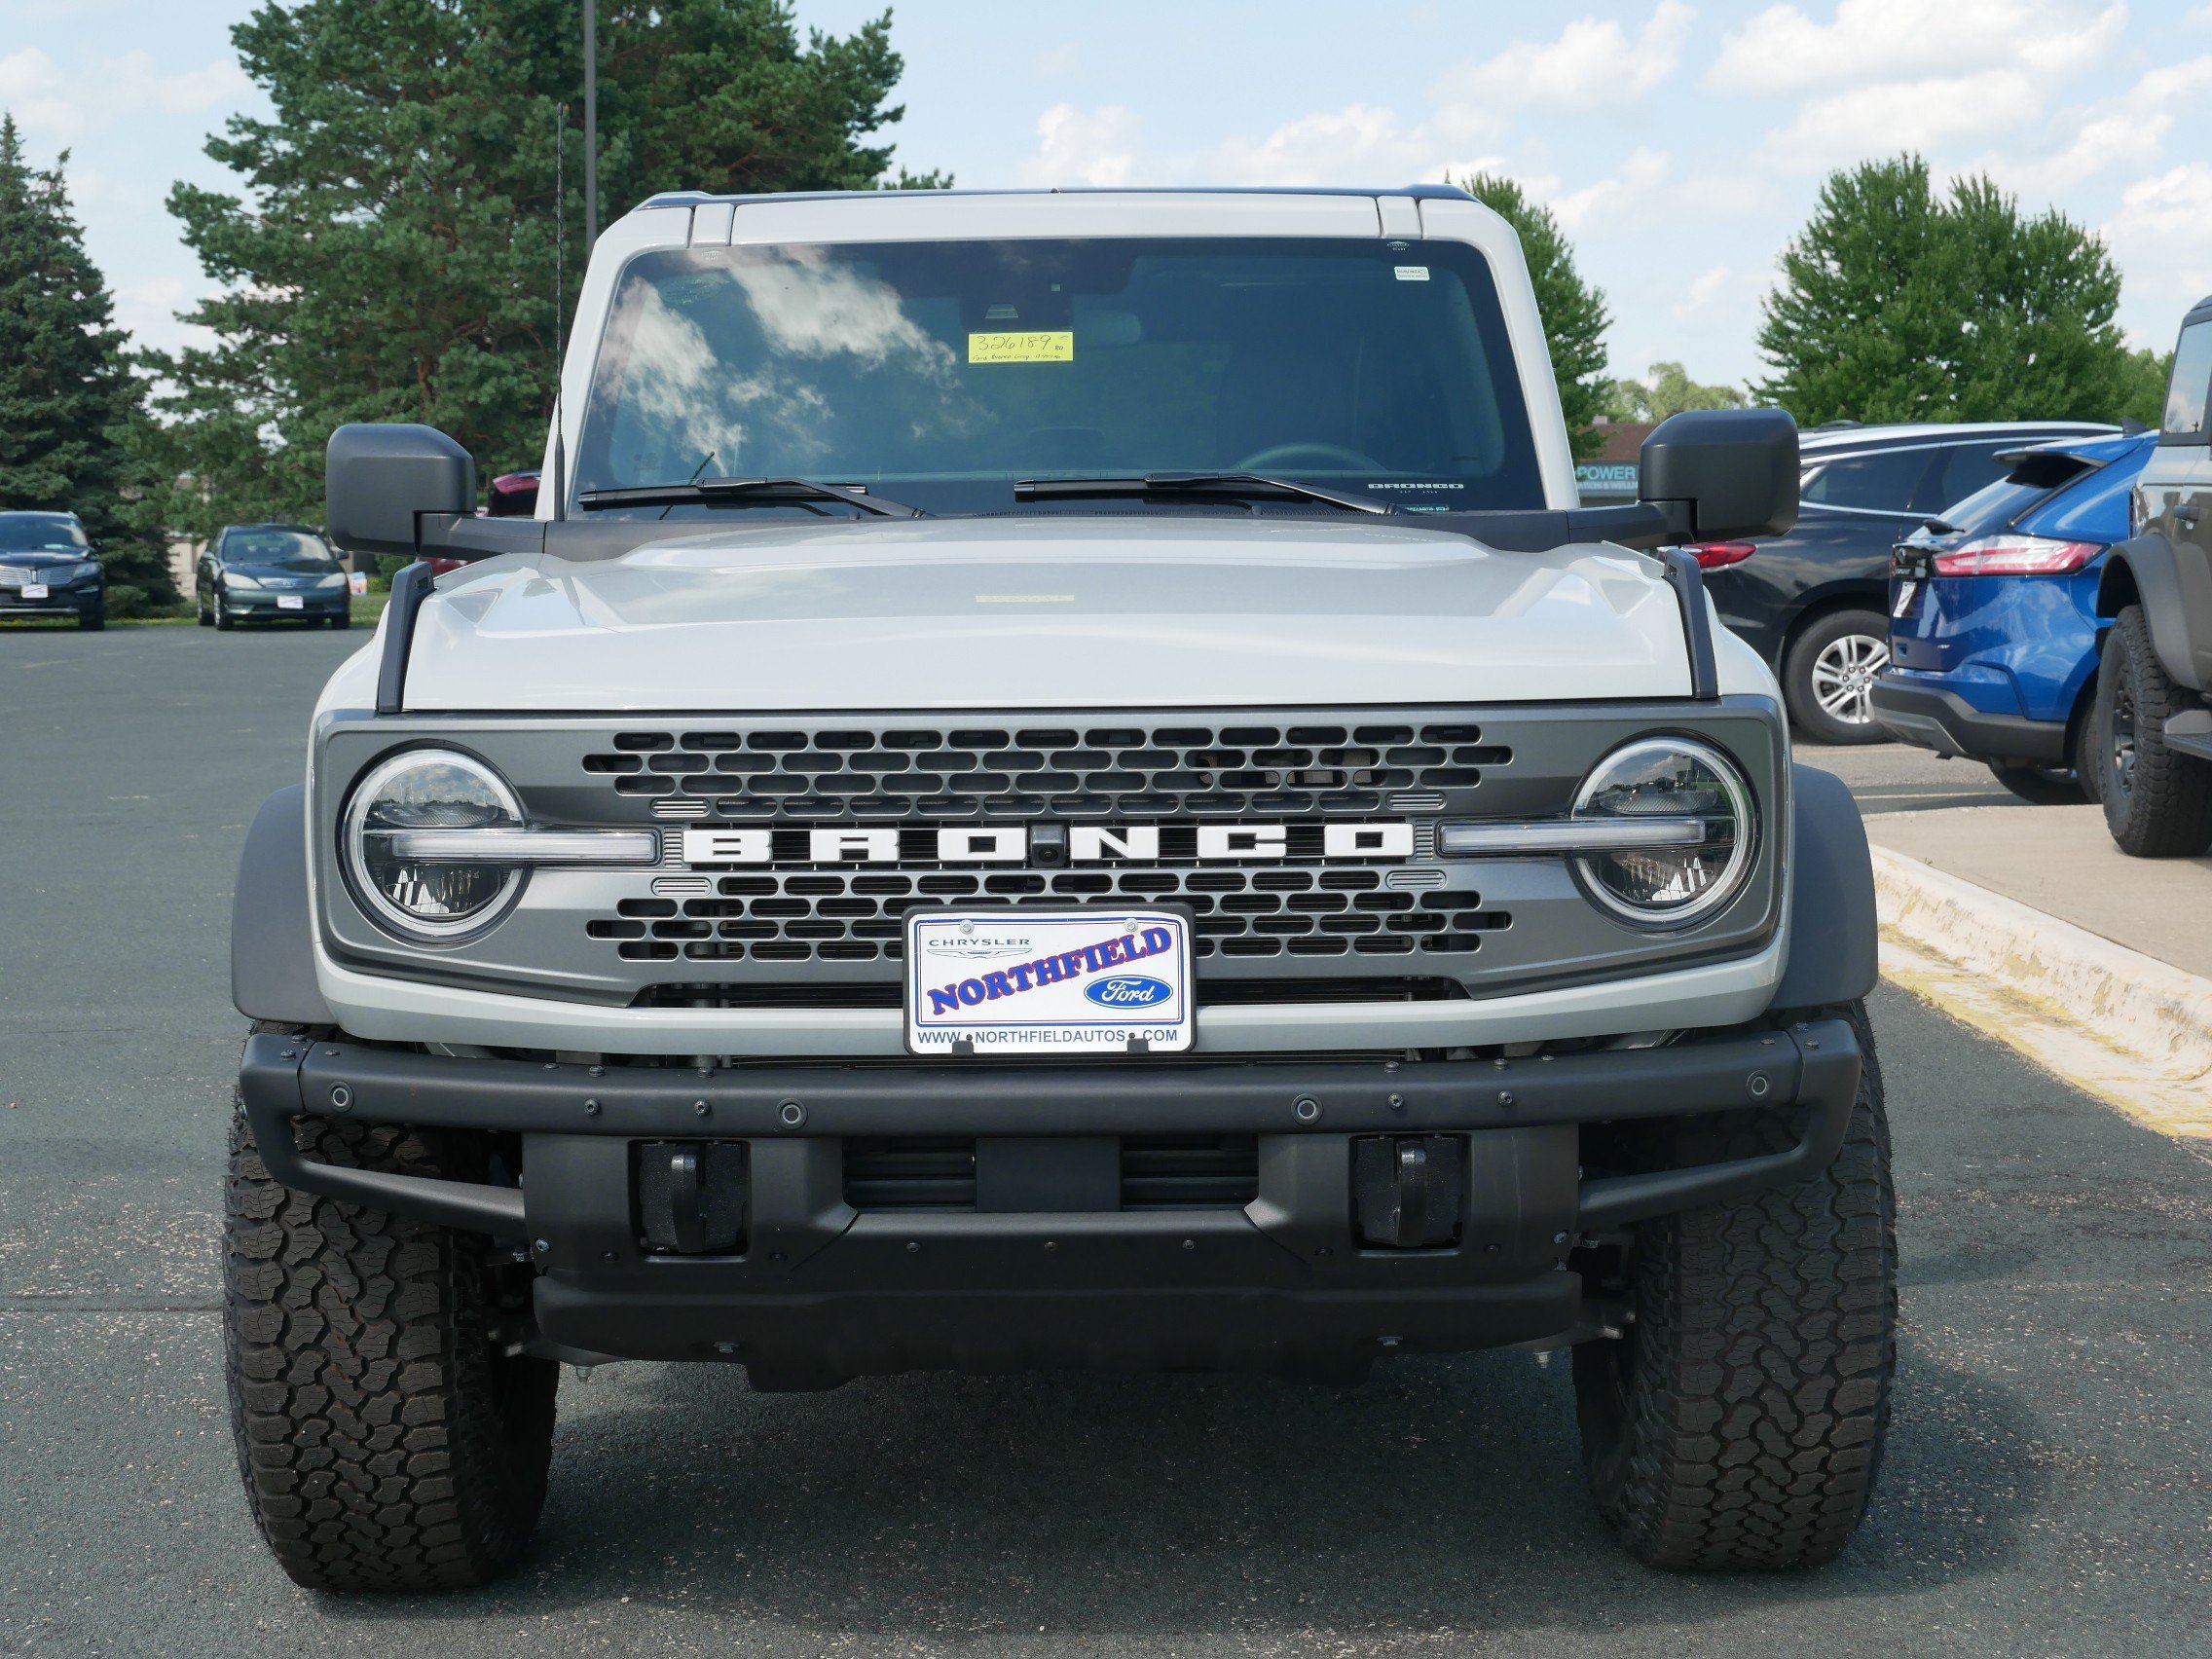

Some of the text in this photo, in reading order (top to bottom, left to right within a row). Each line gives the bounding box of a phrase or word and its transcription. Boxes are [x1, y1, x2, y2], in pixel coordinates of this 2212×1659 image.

[977, 334, 1051, 350] 326189
[682, 822, 1414, 863] BRONCO
[929, 938, 1030, 946] CHRYSLER
[927, 926, 1172, 1016] NORTHFIELD
[1101, 979, 1156, 1003] Ford
